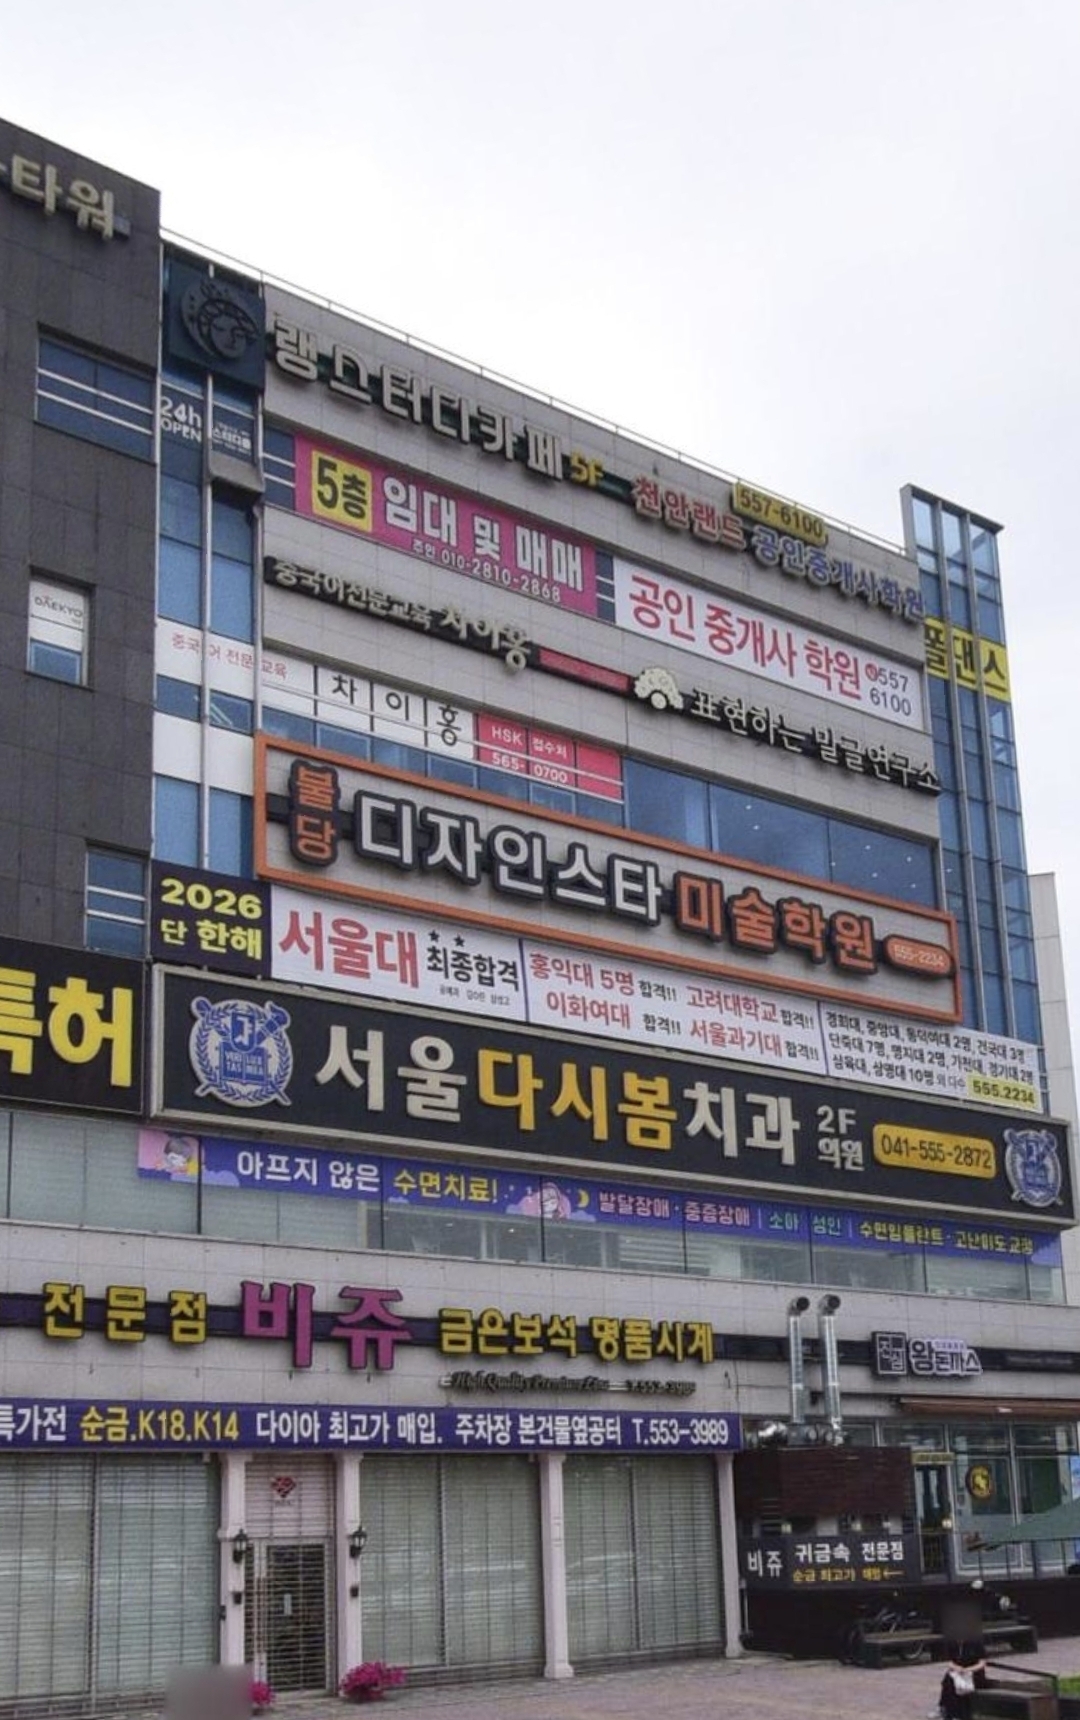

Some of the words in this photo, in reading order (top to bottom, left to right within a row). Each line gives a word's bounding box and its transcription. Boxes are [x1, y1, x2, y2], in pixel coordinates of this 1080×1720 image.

[0, 154, 114, 239] 타워
[160, 396, 202, 429] 24h
[274, 319, 564, 481] 랭스터디카페
[570, 452, 604, 486] 5F
[160, 417, 202, 443] OPEN
[316, 457, 370, 520] 5층
[383, 476, 458, 548] 임대
[473, 513, 501, 562] 및
[514, 525, 584, 592] 매매
[737, 487, 824, 538] 557-6100
[633, 477, 745, 549] 천안랜드
[752, 525, 926, 621] 공인중개사학원
[274, 560, 433, 630] 중국어전문교육
[441, 549, 562, 603] 010-2810-2868
[629, 573, 695, 643] 공인
[704, 602, 797, 676] 중개사
[804, 638, 862, 700] 학원
[924, 616, 1006, 692] 폴댄스
[690, 687, 806, 753] 표현하는
[869, 686, 912, 716] 6100
[491, 726, 522, 746] HSK
[296, 764, 336, 861] 불당
[160, 877, 263, 920] 2026
[160, 918, 188, 946] 단
[278, 911, 420, 989] 서울대
[426, 945, 520, 992] 최종합격
[529, 951, 594, 989] 홍익대
[600, 968, 635, 997] 5명
[638, 979, 677, 1002] 합격!!
[686, 985, 779, 1024] 고려대학교
[780, 1008, 814, 1031] 합격!!
[546, 991, 631, 1030] 이화여대
[642, 1013, 681, 1036] 합격!!
[689, 1018, 783, 1058] 서울과기대
[784, 1040, 820, 1062] 합격!!
[816, 1105, 857, 1134] 2F
[237, 1150, 318, 1186] 아프지
[328, 1160, 380, 1193] 않은
[393, 1168, 498, 1203] 수면치료!
[817, 1136, 865, 1172] 의원
[880, 1134, 993, 1171] 041-555-2872
[241, 1280, 412, 1370] 비쥬
[440, 1307, 578, 1358] 금은보석
[590, 1317, 715, 1364] 명품시계
[81, 1407, 240, 1443] 순금.K18.K14
[256, 1411, 321, 1443] 다이아
[329, 1412, 391, 1443] 최고가
[397, 1413, 443, 1445] 매입.
[455, 1415, 513, 1445] 주차장
[518, 1416, 622, 1446] 본건물옆공터
[632, 1418, 729, 1446] T.553-3989
[747, 1549, 782, 1578] 비쥬
[795, 1543, 850, 1563] 귀금속
[862, 1541, 904, 1562] 전문점
